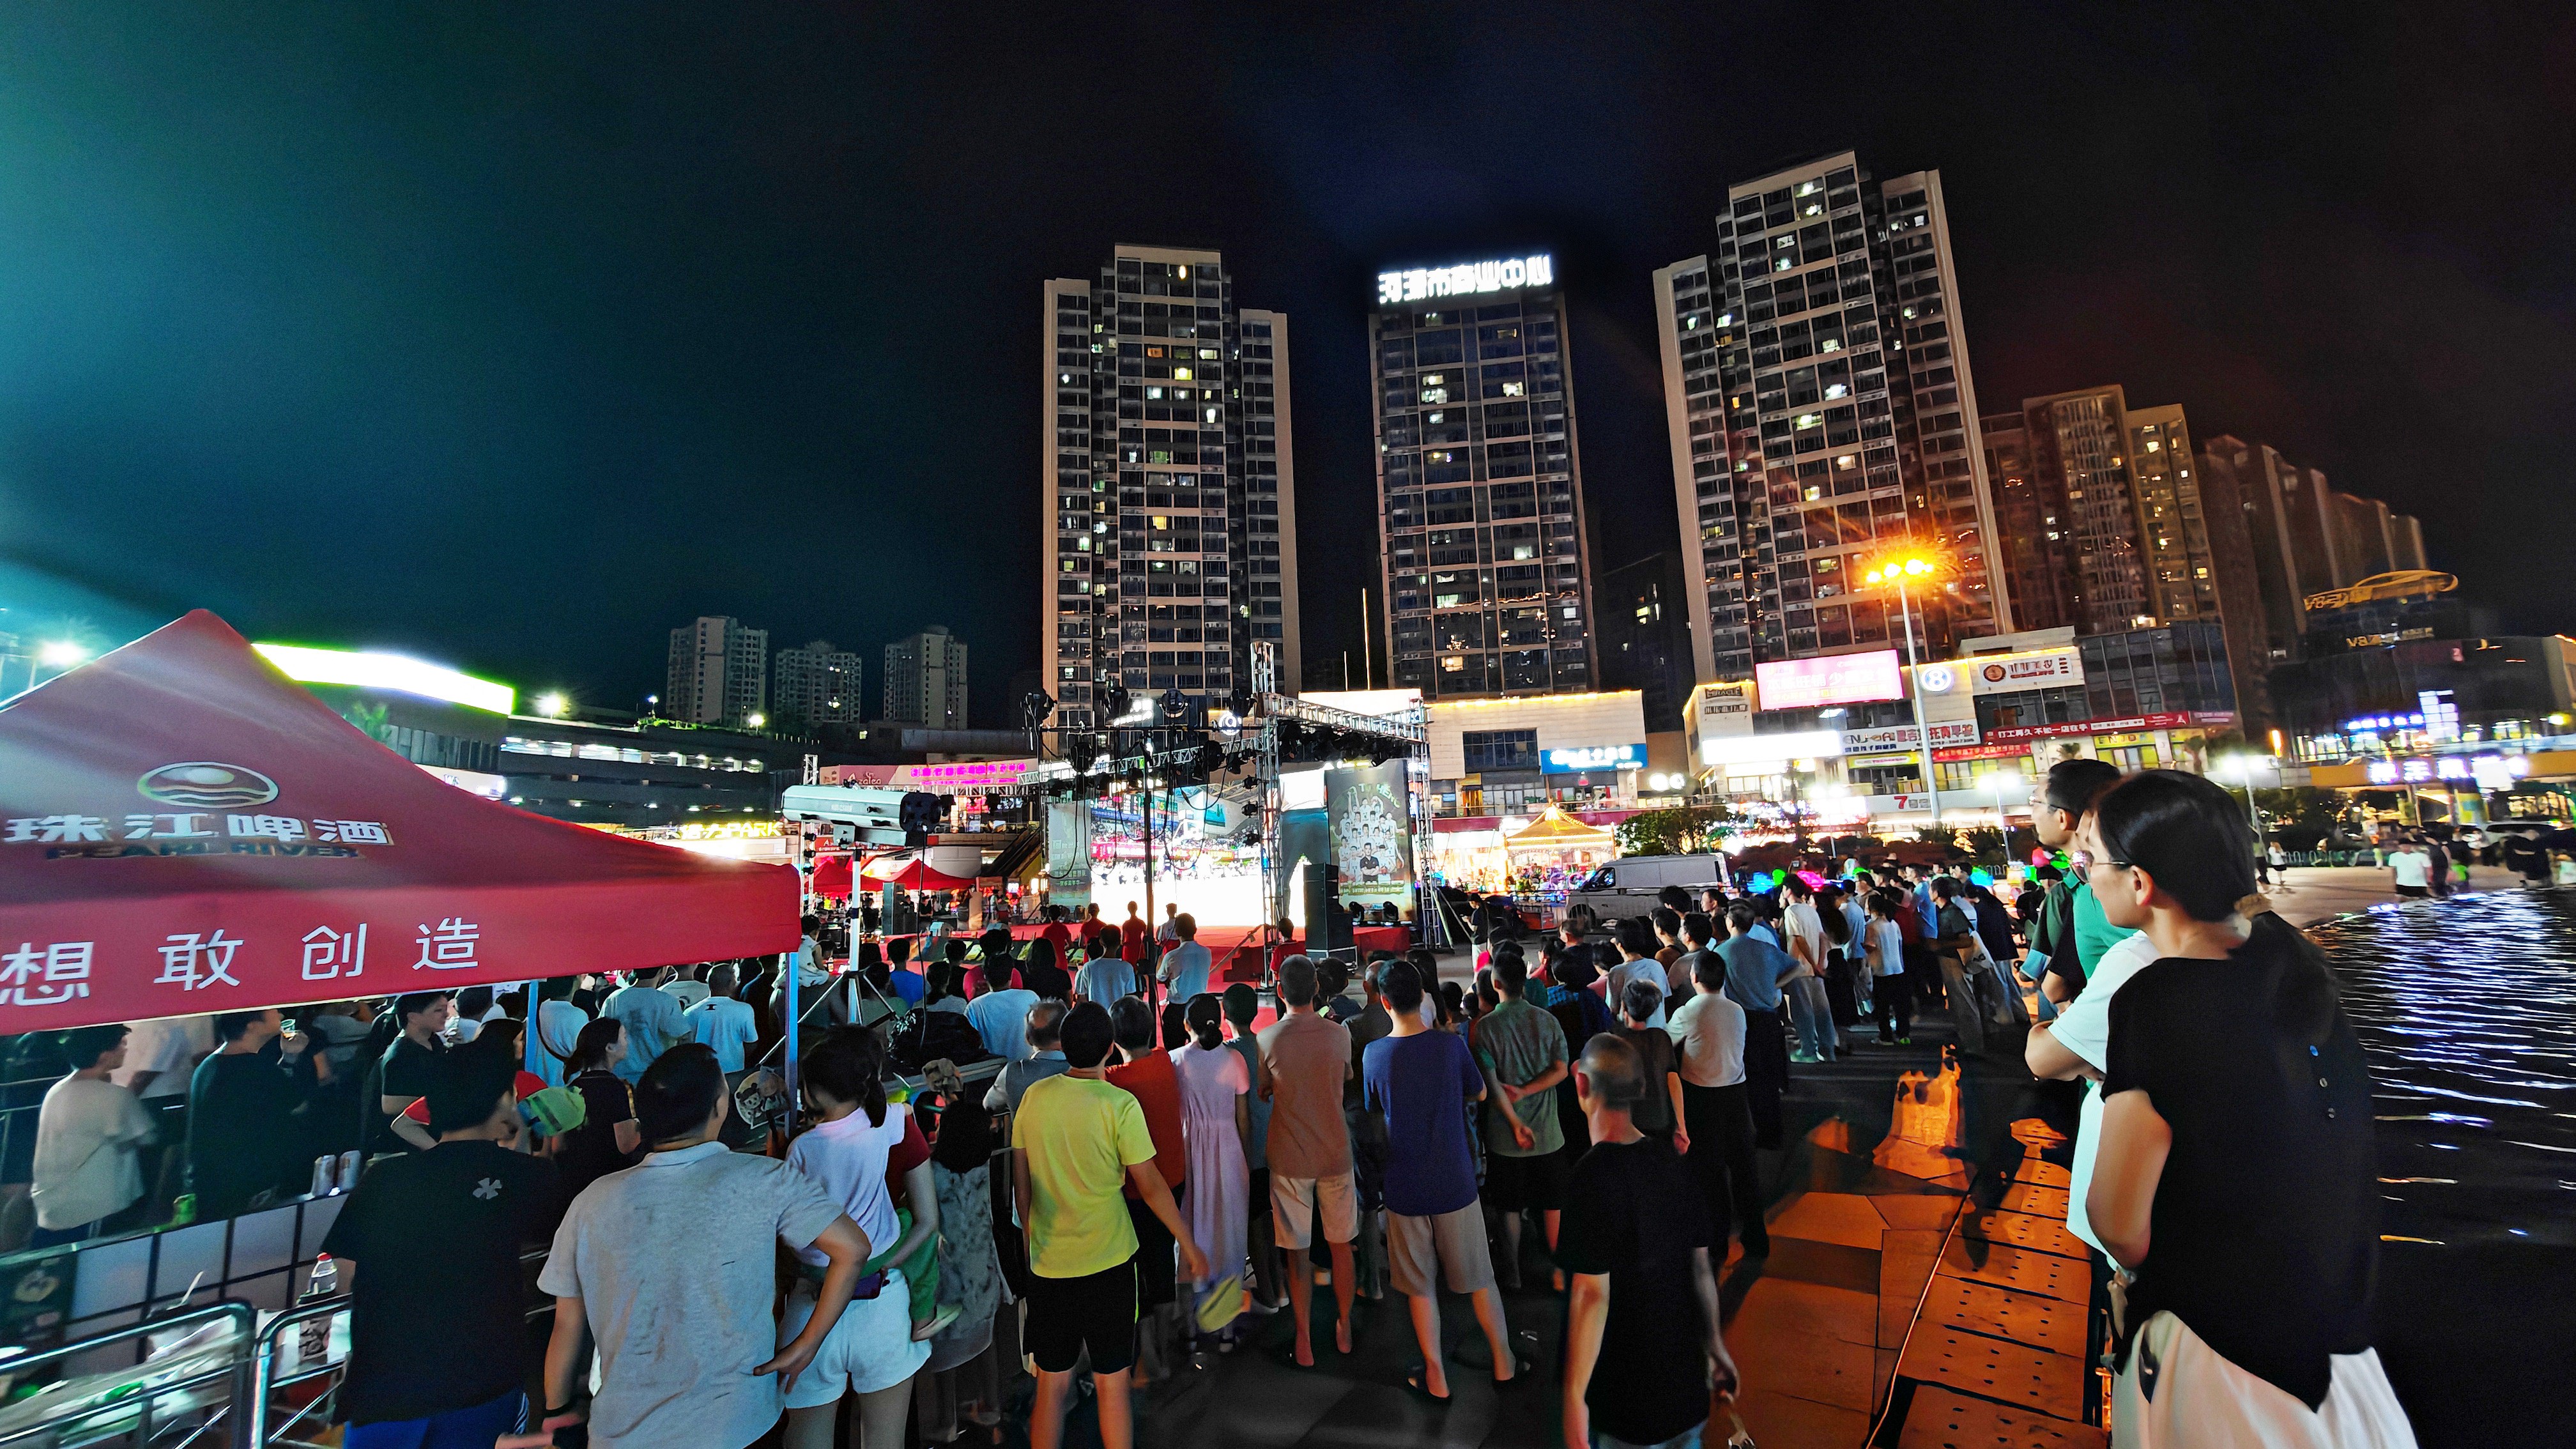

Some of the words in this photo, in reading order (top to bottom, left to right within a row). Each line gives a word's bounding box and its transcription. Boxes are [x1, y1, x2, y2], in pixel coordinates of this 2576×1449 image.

[3, 813, 392, 845] 珠江啤酒
[0, 917, 480, 1007] 想敢创造
